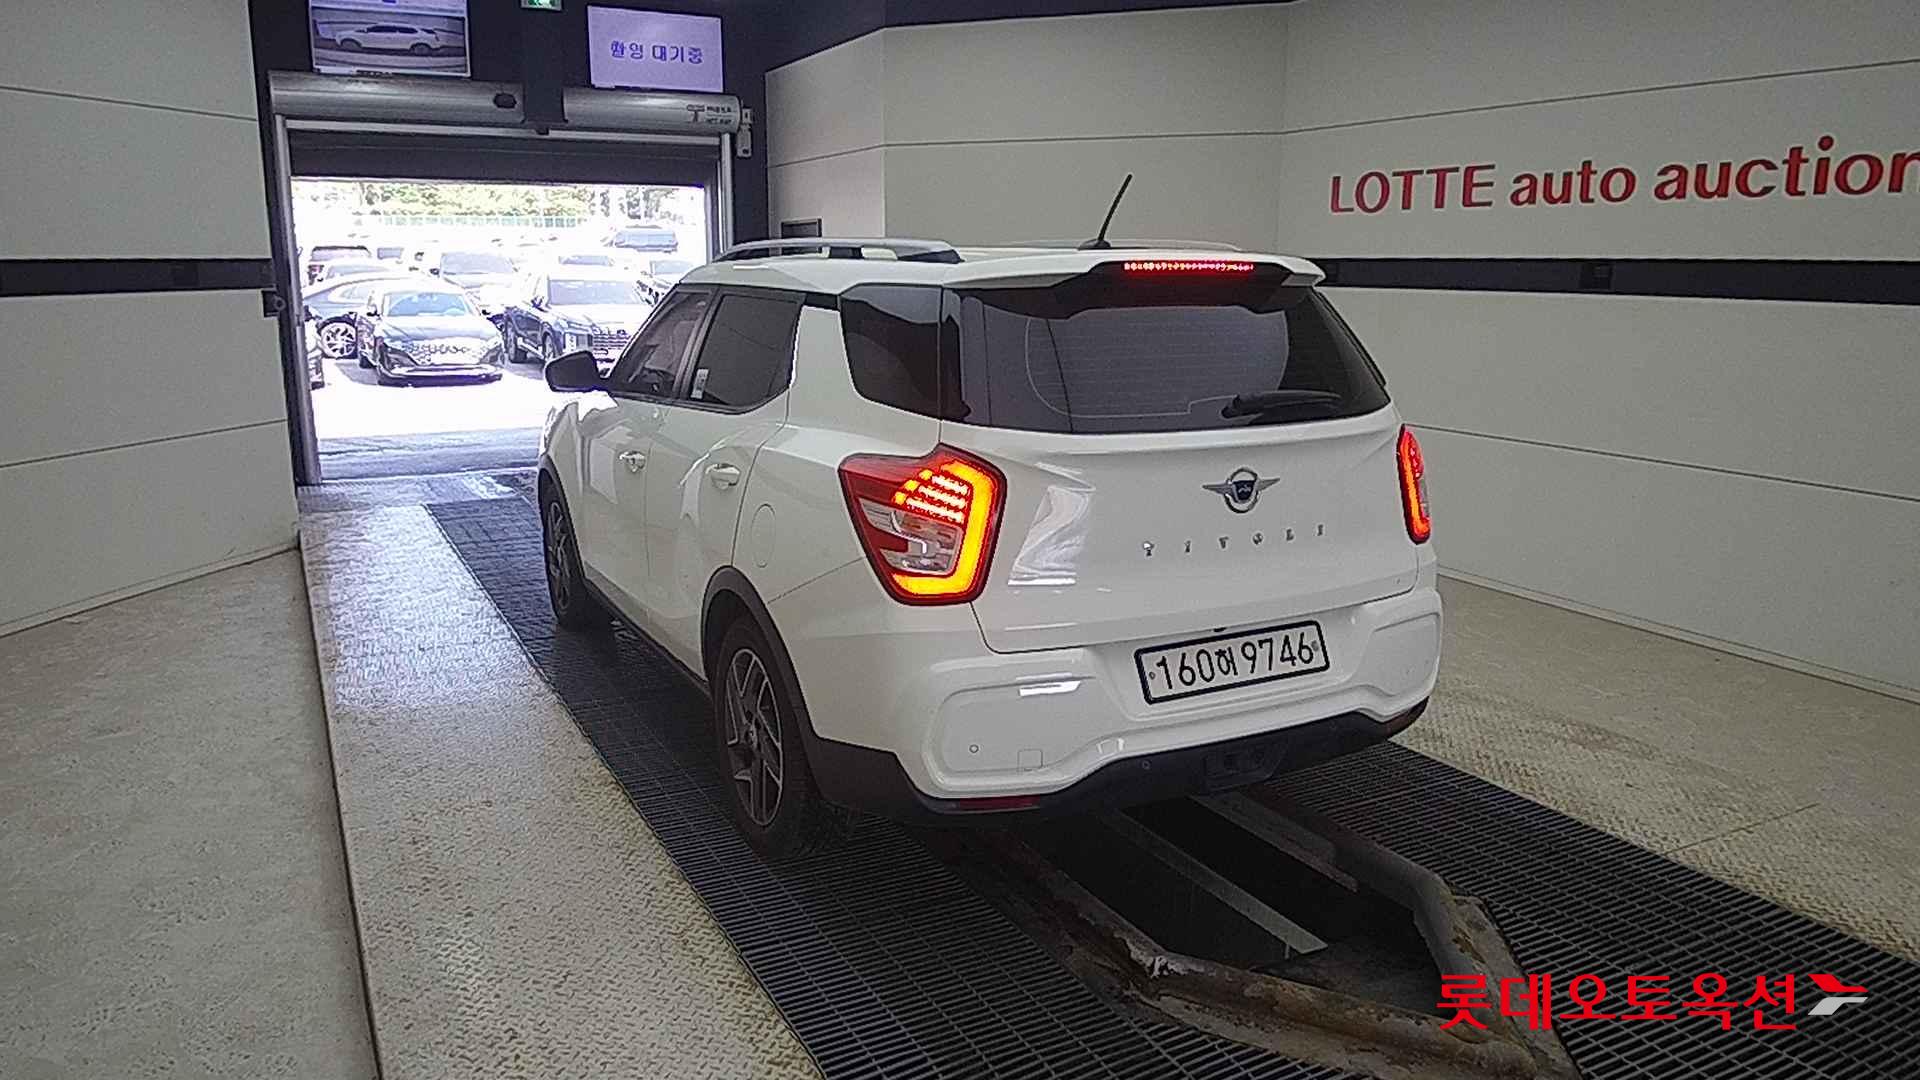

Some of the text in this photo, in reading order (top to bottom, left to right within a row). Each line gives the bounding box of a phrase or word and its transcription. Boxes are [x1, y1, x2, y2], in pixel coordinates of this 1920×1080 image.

[652, 45, 703, 64] 대기중
[1330, 165, 1496, 213] LOTTE
[1510, 161, 1637, 206] auto
